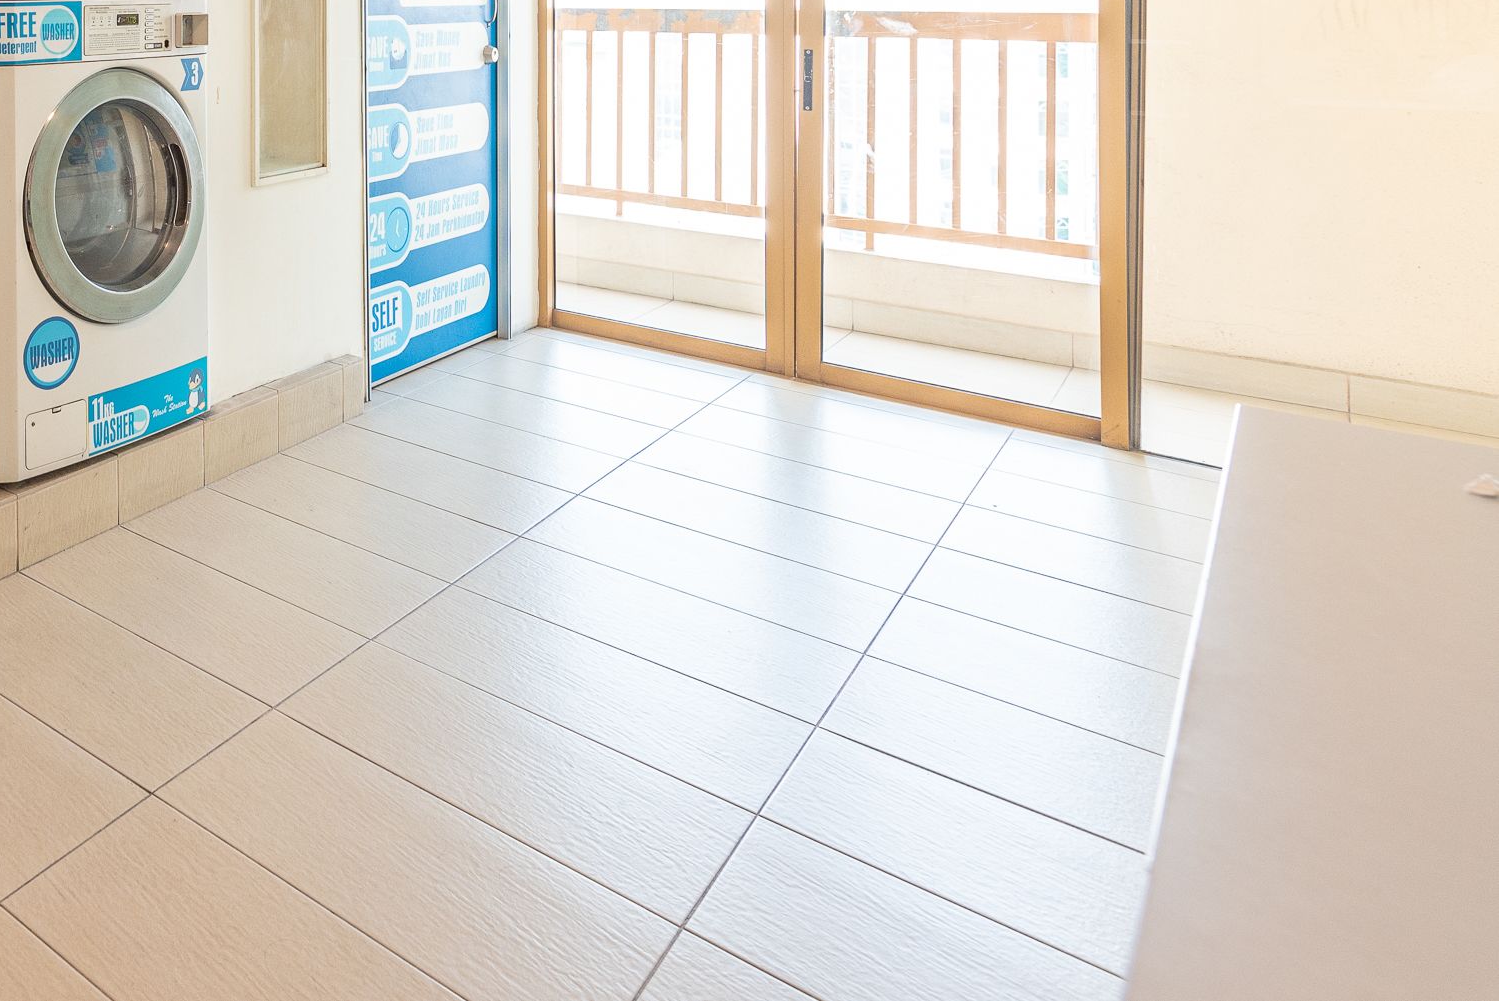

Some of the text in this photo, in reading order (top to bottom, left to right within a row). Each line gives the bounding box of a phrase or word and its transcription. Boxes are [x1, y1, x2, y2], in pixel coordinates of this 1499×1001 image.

[42, 22, 75, 41] WASHER
[415, 30, 435, 48] Save
[191, 61, 199, 86] 3
[416, 112, 454, 133] Save Time
[415, 135, 437, 155] Jimat
[416, 190, 479, 219] 24 Hours Service
[369, 211, 386, 243] 24
[415, 225, 424, 242] 24
[426, 222, 441, 239] Jam
[416, 271, 486, 308] Self Service Laundry
[372, 297, 398, 333] SELF
[415, 310, 431, 330] Dobi
[432, 303, 453, 324] Layan
[29, 336, 75, 370] WASHER
[373, 331, 398, 352] SERVICE
[91, 396, 115, 420] 11KG
[152, 399, 188, 418] Wash Station
[163, 393, 174, 403] The
[92, 411, 135, 449] WASHER
